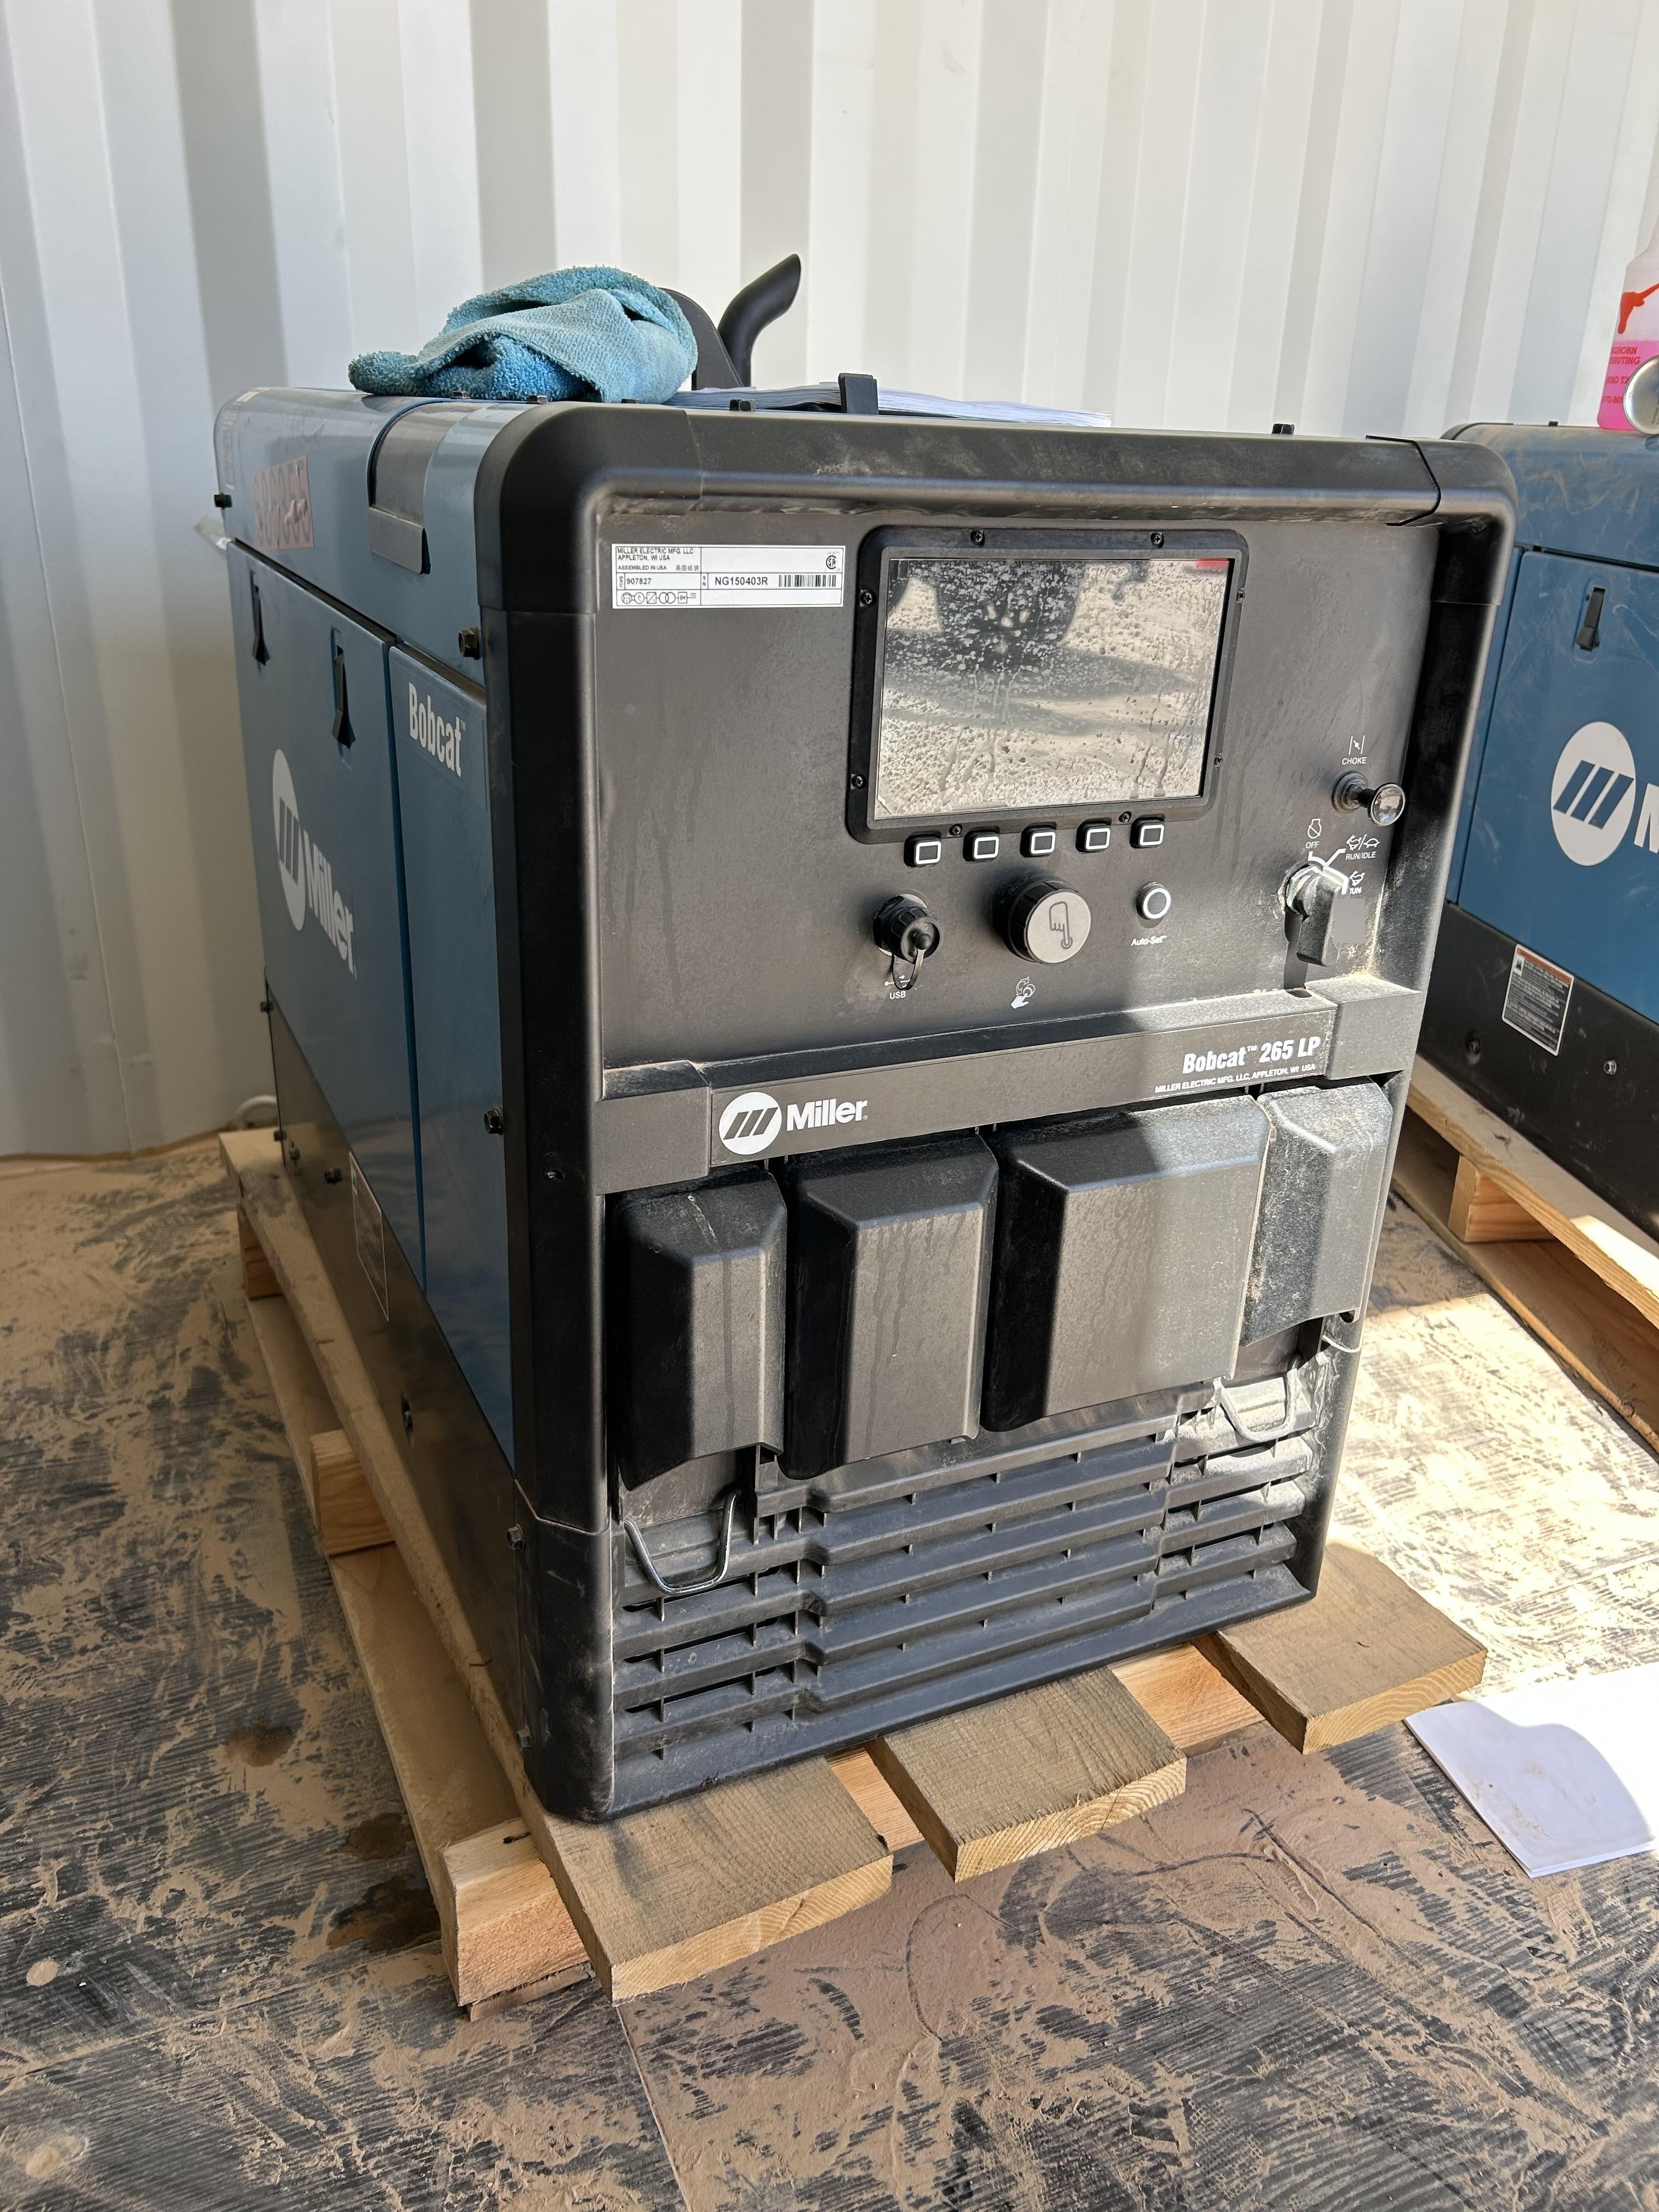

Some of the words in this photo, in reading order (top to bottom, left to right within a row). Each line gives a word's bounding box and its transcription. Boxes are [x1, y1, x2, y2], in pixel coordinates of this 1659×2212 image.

[715, 577, 768, 585] NG150403R
[1341, 757, 1367, 765] CHOKE
[1306, 840, 1319, 849] OFF
[303, 829, 354, 975] Miller
[889, 991, 906, 1000] USB
[1259, 1040, 1294, 1063] 265
[1297, 1036, 1322, 1057] LP
[1154, 1082, 1181, 1093] MILLER
[1182, 1077, 1216, 1090] ELECTRIC
[1217, 1075, 1234, 1084] MFG.
[1251, 1067, 1289, 1079] APPLETON,
[1290, 1065, 1300, 1074] WI
[1301, 1063, 1316, 1072] USA
[787, 1098, 868, 1131] Miller
